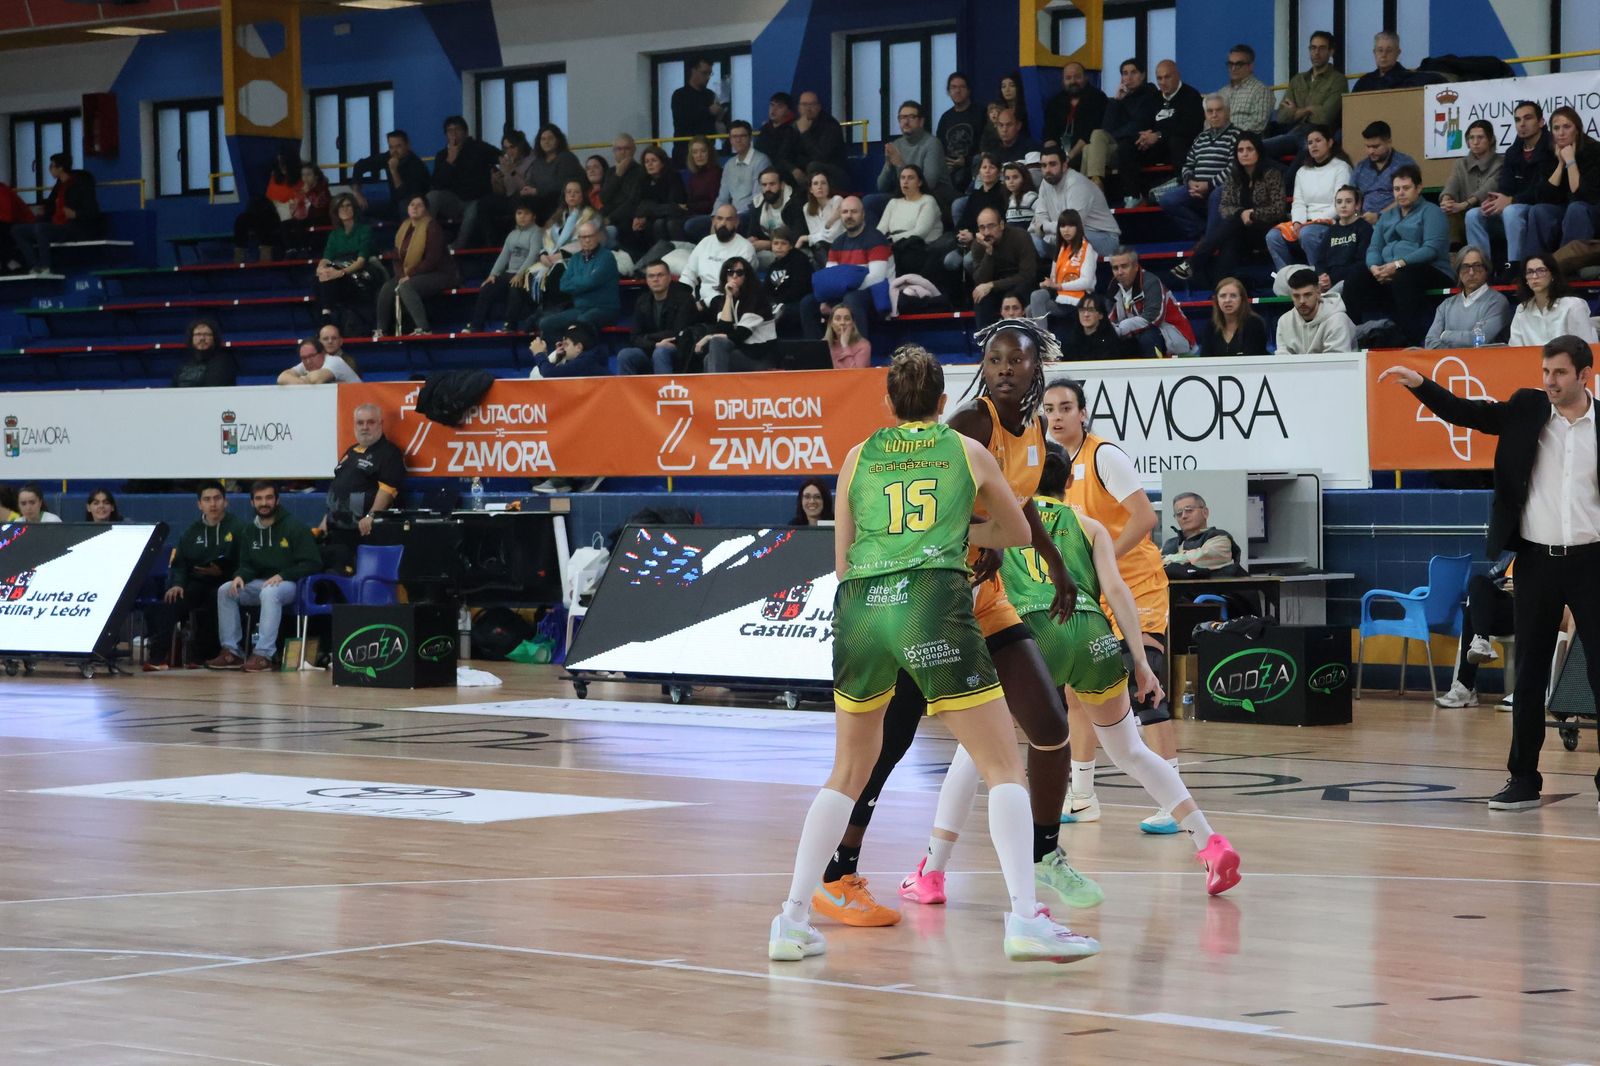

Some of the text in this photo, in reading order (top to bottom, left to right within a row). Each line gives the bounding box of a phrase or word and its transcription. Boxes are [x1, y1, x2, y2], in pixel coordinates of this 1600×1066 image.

[1468, 92, 1600, 121] AYUNMIENTO
[1072, 374, 1289, 442] AMORA
[21, 426, 70, 446] ZAMORA
[240, 422, 293, 442] ZAMORA
[448, 440, 557, 472] ZAMORA
[709, 436, 833, 470] ZAMORA
[884, 479, 937, 535] 15
[26, 590, 98, 602] Junta de
[33, 607, 48, 620] y
[50, 604, 91, 617] León
[739, 622, 816, 638] Castilla
